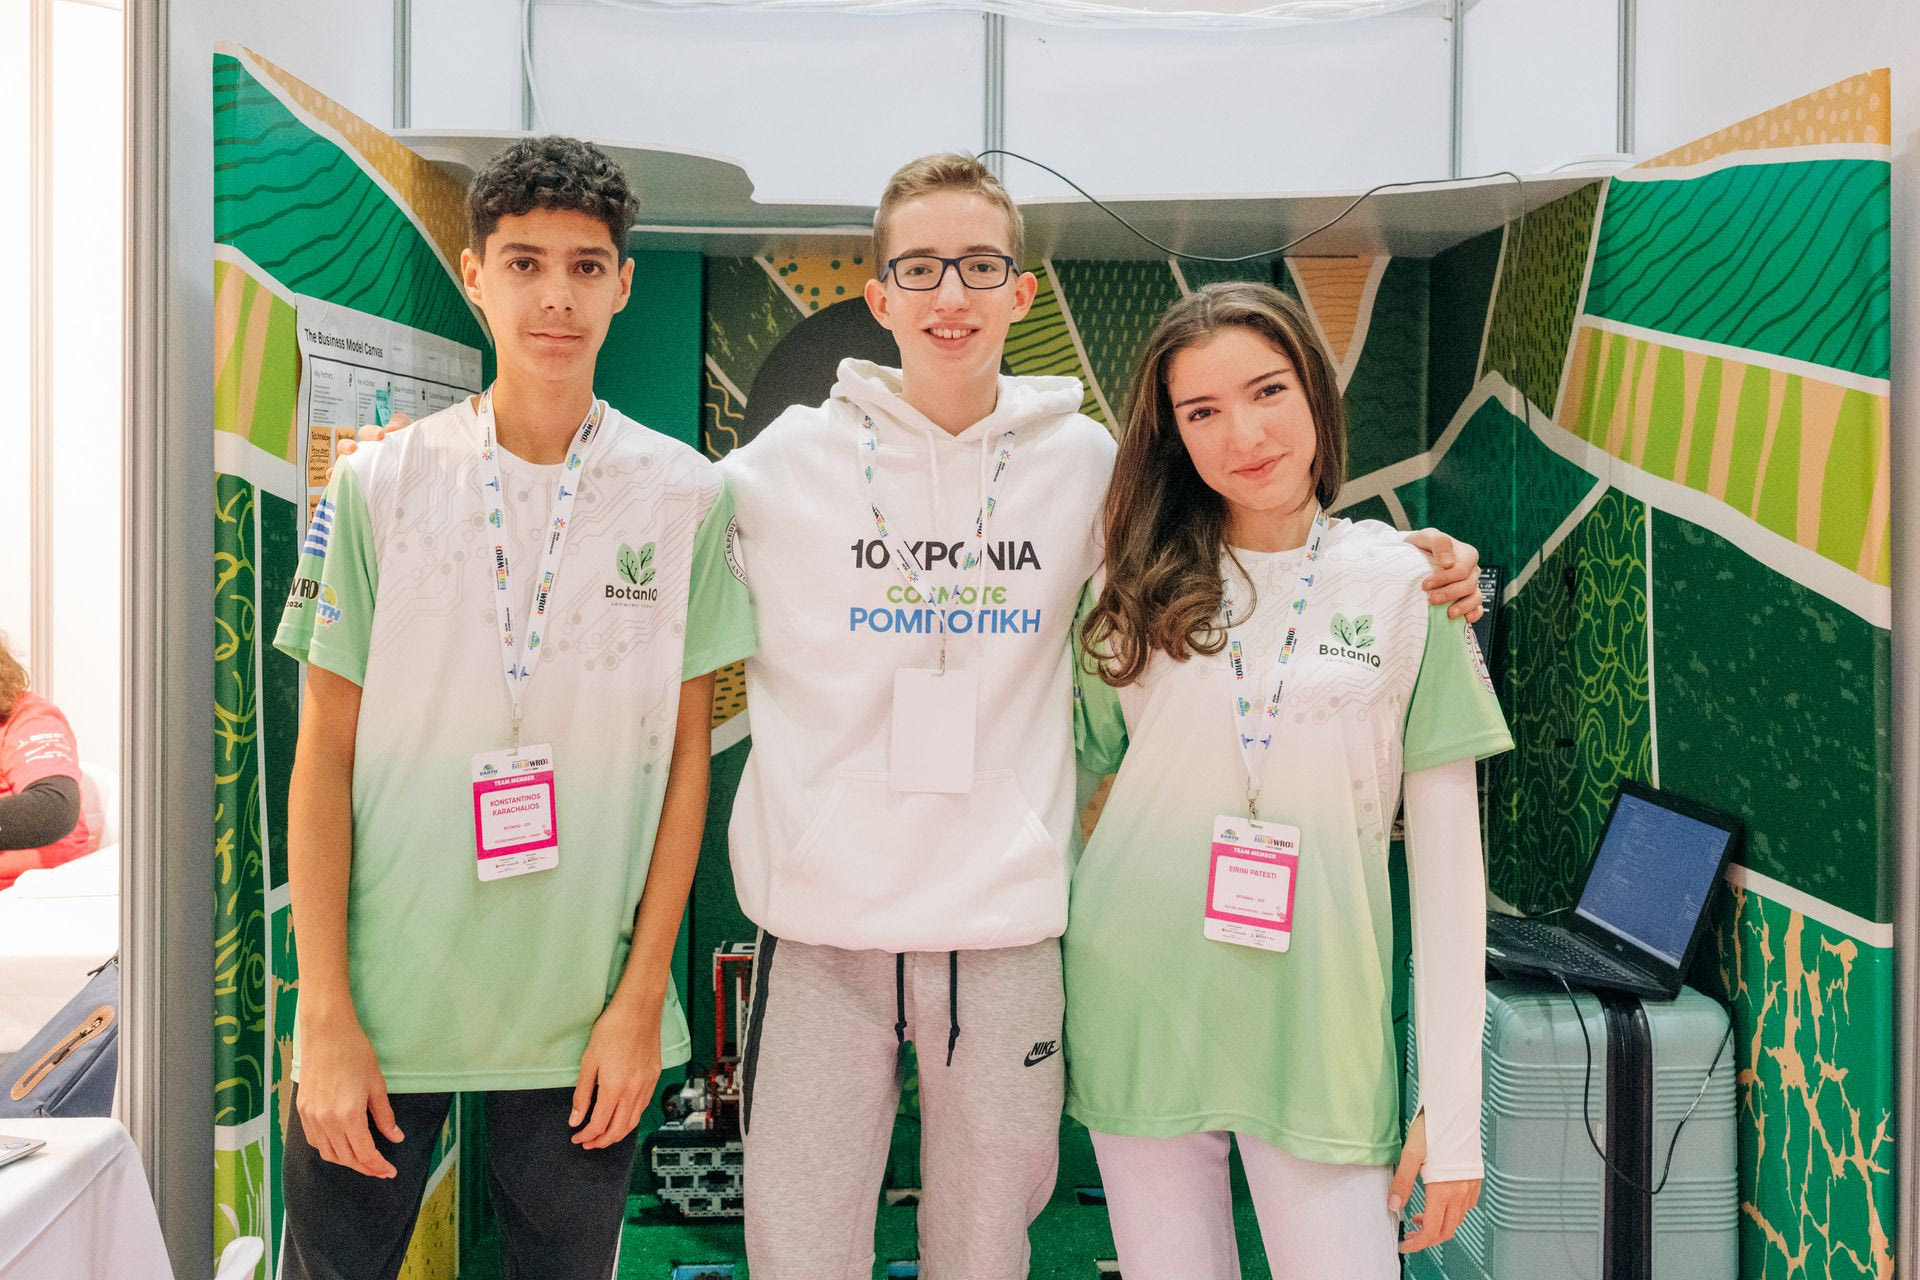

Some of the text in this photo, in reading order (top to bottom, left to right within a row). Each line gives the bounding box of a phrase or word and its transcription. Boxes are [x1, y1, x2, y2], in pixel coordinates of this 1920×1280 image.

[304, 328, 384, 358] The Business Model Canvas
[495, 548, 505, 569] WRO
[851, 538, 890, 570] 10
[537, 592, 548, 612] WRO
[605, 584, 658, 602] BotanIQ
[886, 584, 1008, 605] COMOTE
[850, 607, 1041, 634] ΡΟΜΠΟΤΙΚΗ
[1319, 644, 1381, 668] BotanIQ
[1234, 658, 1244, 677] WRO
[529, 758, 546, 768] WRO
[494, 775, 535, 787] TEAM MEMBER
[490, 793, 541, 807] KONSTANTINOS
[492, 803, 540, 816] KARACHALIOS
[1233, 847, 1251, 856] TEAM
[1273, 839, 1291, 849] WRO
[1229, 865, 1277, 880] EIRINI PATESTI
[1030, 1040, 1057, 1056] NIKE
